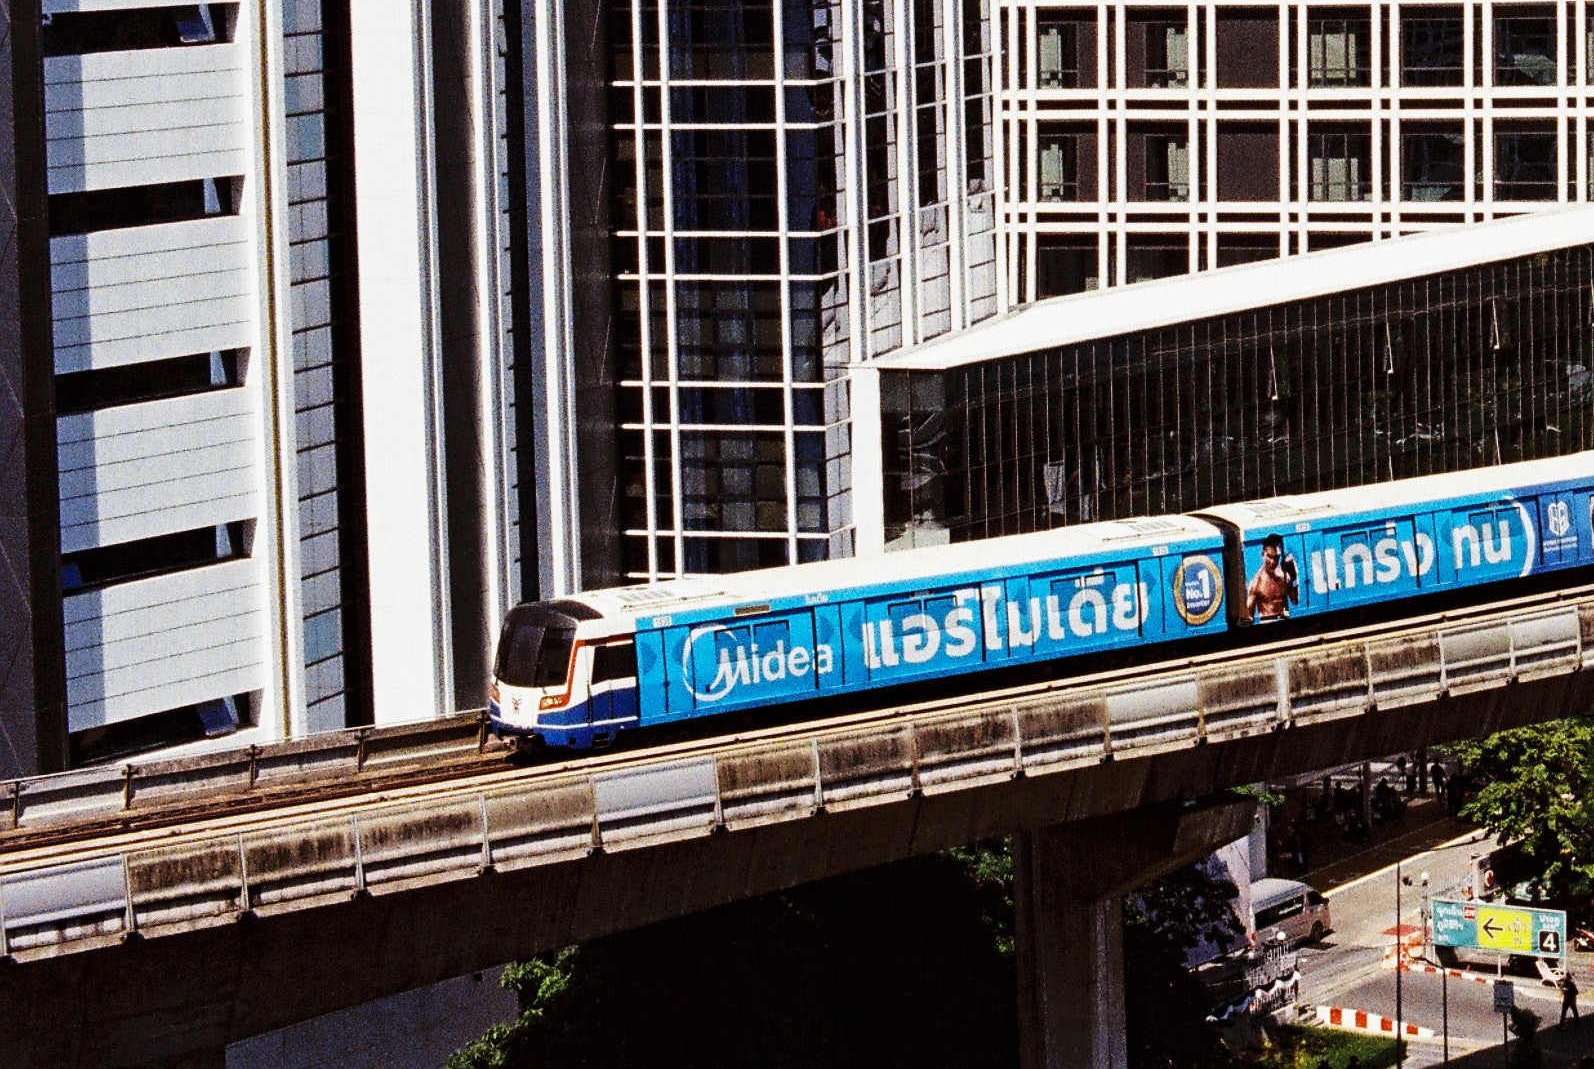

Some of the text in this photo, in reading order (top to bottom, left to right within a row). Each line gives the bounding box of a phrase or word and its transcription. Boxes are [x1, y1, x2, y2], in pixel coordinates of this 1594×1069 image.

[1312, 519, 1512, 594] แกร่ง ทน
[862, 567, 1148, 669] แอร์ไมเดีย
[1542, 933, 1557, 952] 4
